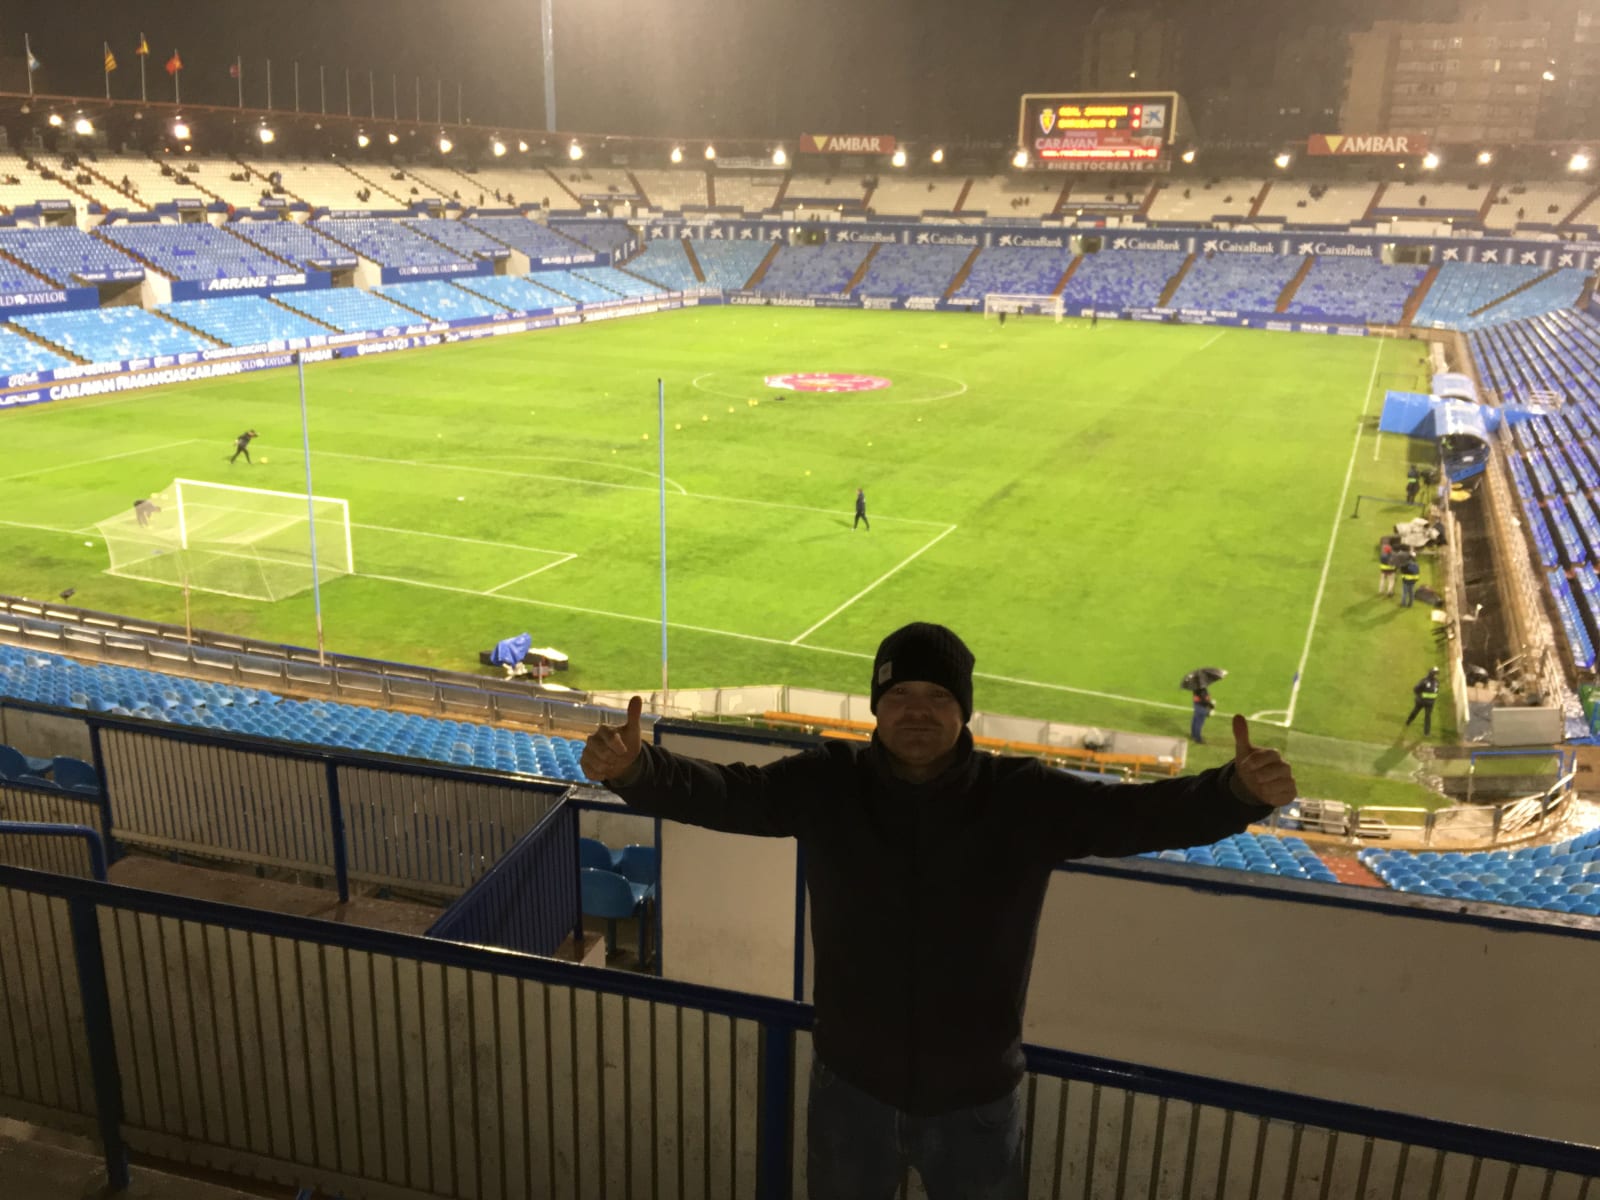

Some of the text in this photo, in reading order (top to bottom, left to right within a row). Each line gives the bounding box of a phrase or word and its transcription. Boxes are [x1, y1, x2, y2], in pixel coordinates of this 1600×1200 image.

[828, 136, 880, 151] AMBAR
[1035, 137, 1097, 150] CARAVAN
[1342, 136, 1408, 153] AMBAR
[1013, 235, 1063, 247] CaixaBank
[1128, 237, 1181, 251] CaixaBank
[1219, 240, 1274, 253] CaixaBank
[1315, 242, 1374, 256] CaixaBank
[208, 276, 268, 291] ARRANZ
[27, 291, 67, 302] TAYLOR
[240, 354, 293, 370] OLD TAYLOR
[50, 378, 115, 400] CARAVAN
